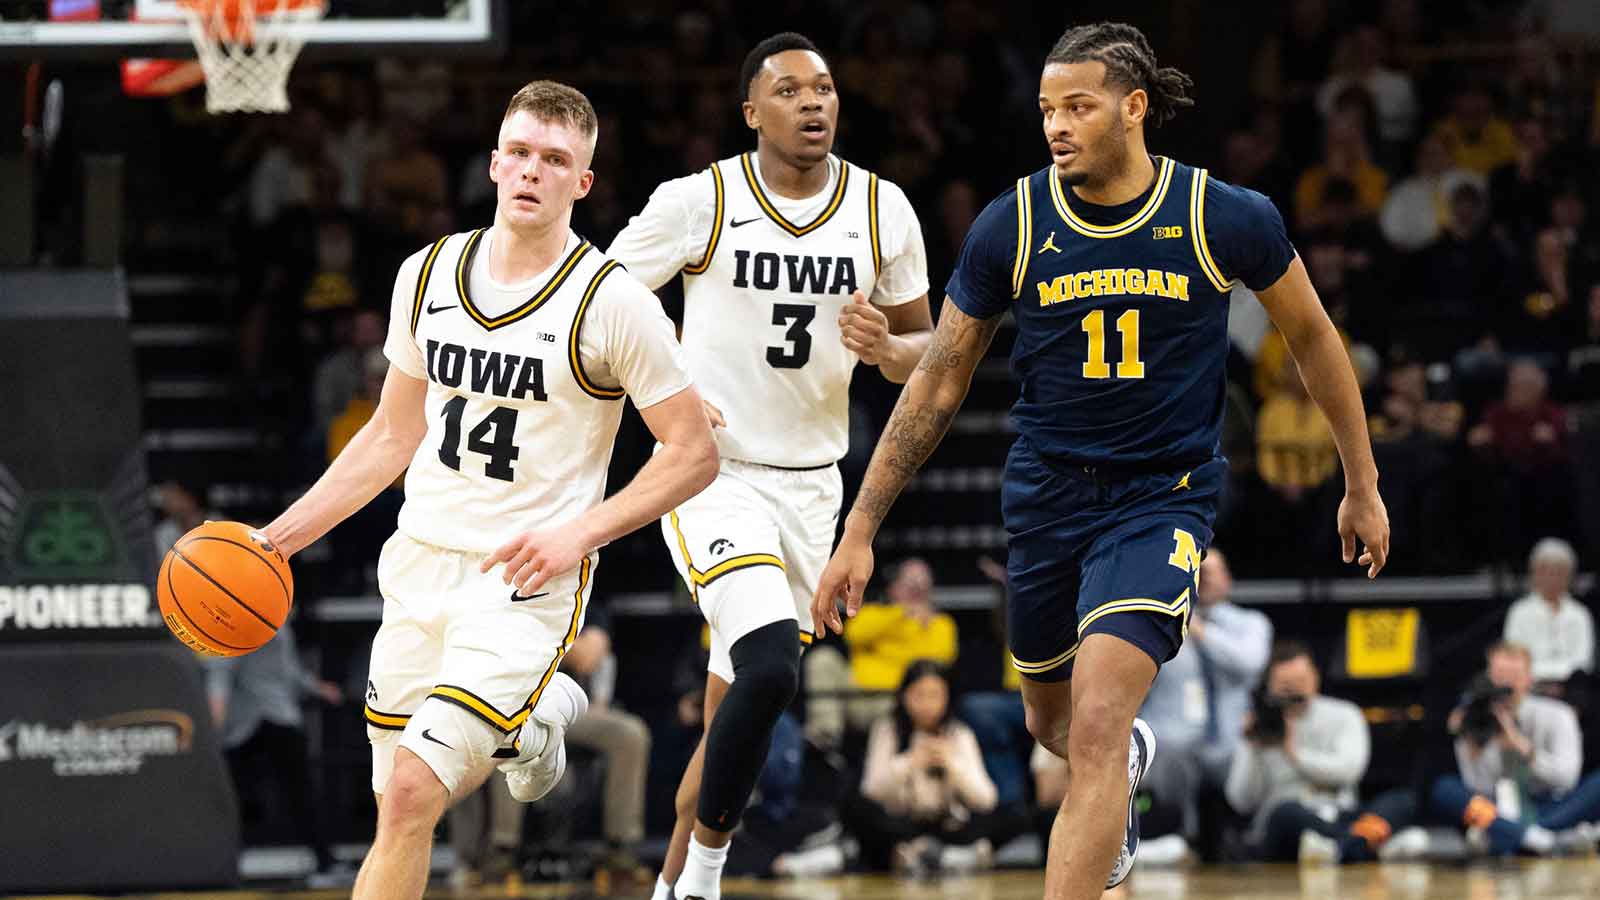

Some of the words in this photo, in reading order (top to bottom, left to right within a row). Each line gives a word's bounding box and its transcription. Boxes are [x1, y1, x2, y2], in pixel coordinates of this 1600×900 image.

[733, 250, 858, 295] IOWA
[1037, 268, 1189, 307] MICHIGAN
[766, 303, 816, 369] 3
[1081, 309, 1145, 378] 11
[426, 338, 548, 402] IOWA
[438, 395, 520, 482] 14
